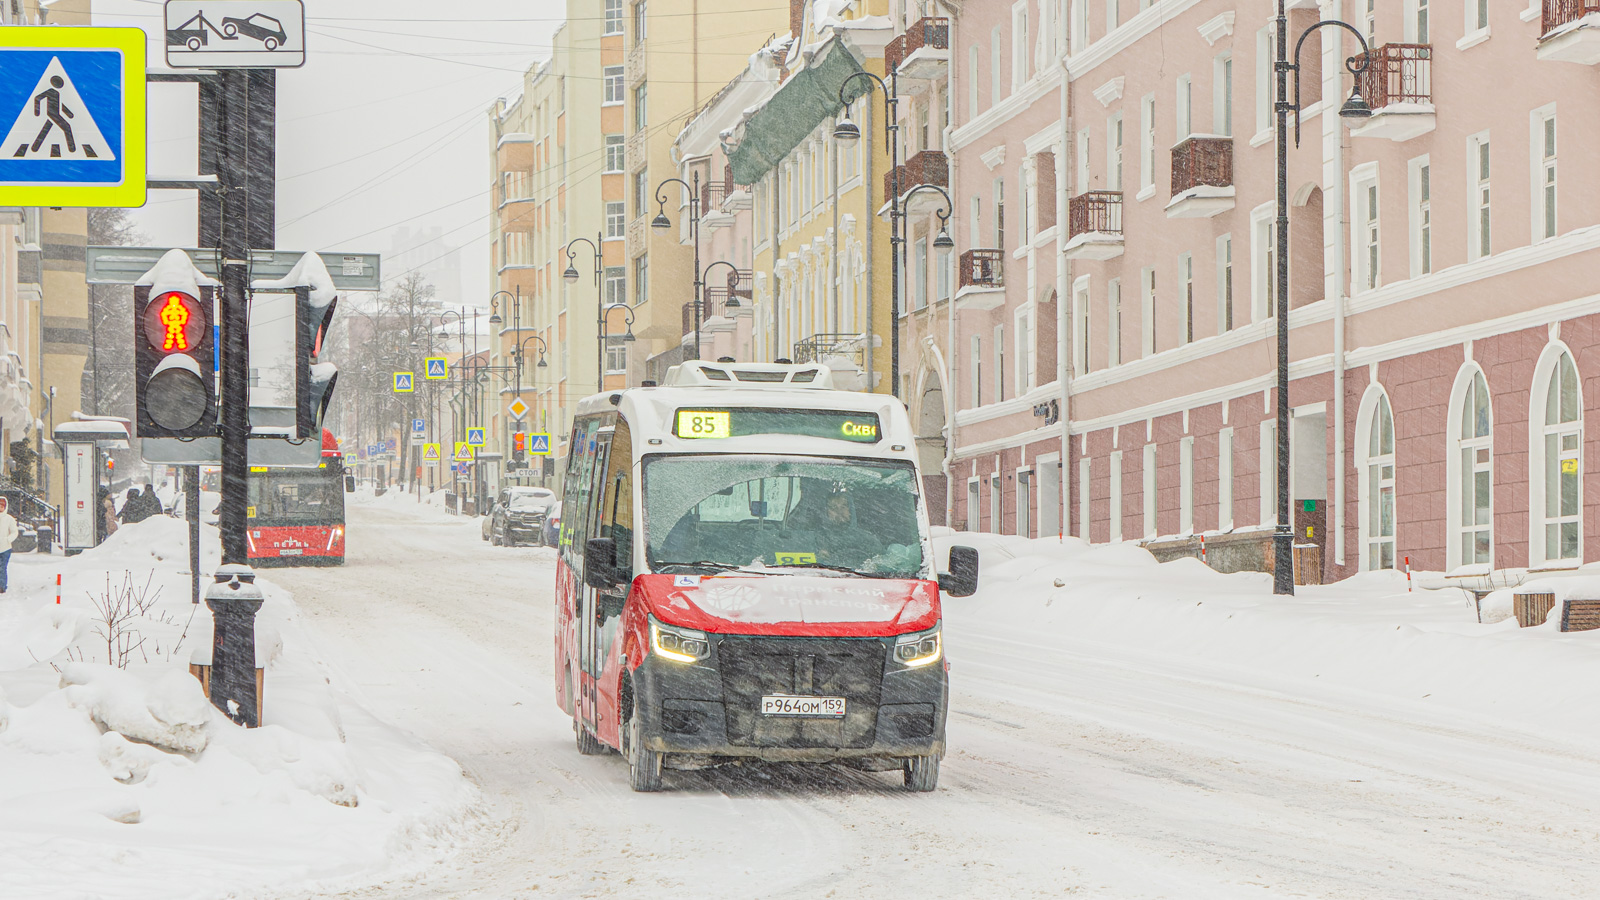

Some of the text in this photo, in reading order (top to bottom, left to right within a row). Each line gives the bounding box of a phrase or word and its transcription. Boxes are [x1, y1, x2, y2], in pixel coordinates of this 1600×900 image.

[415, 420, 423, 431] P
[692, 416, 715, 433] 85
[273, 539, 309, 548] ПЕРМЬ
[772, 583, 886, 599] Пермский
[775, 596, 890, 612] Транспорт
[765, 699, 842, 713] Р964ОМ 159
